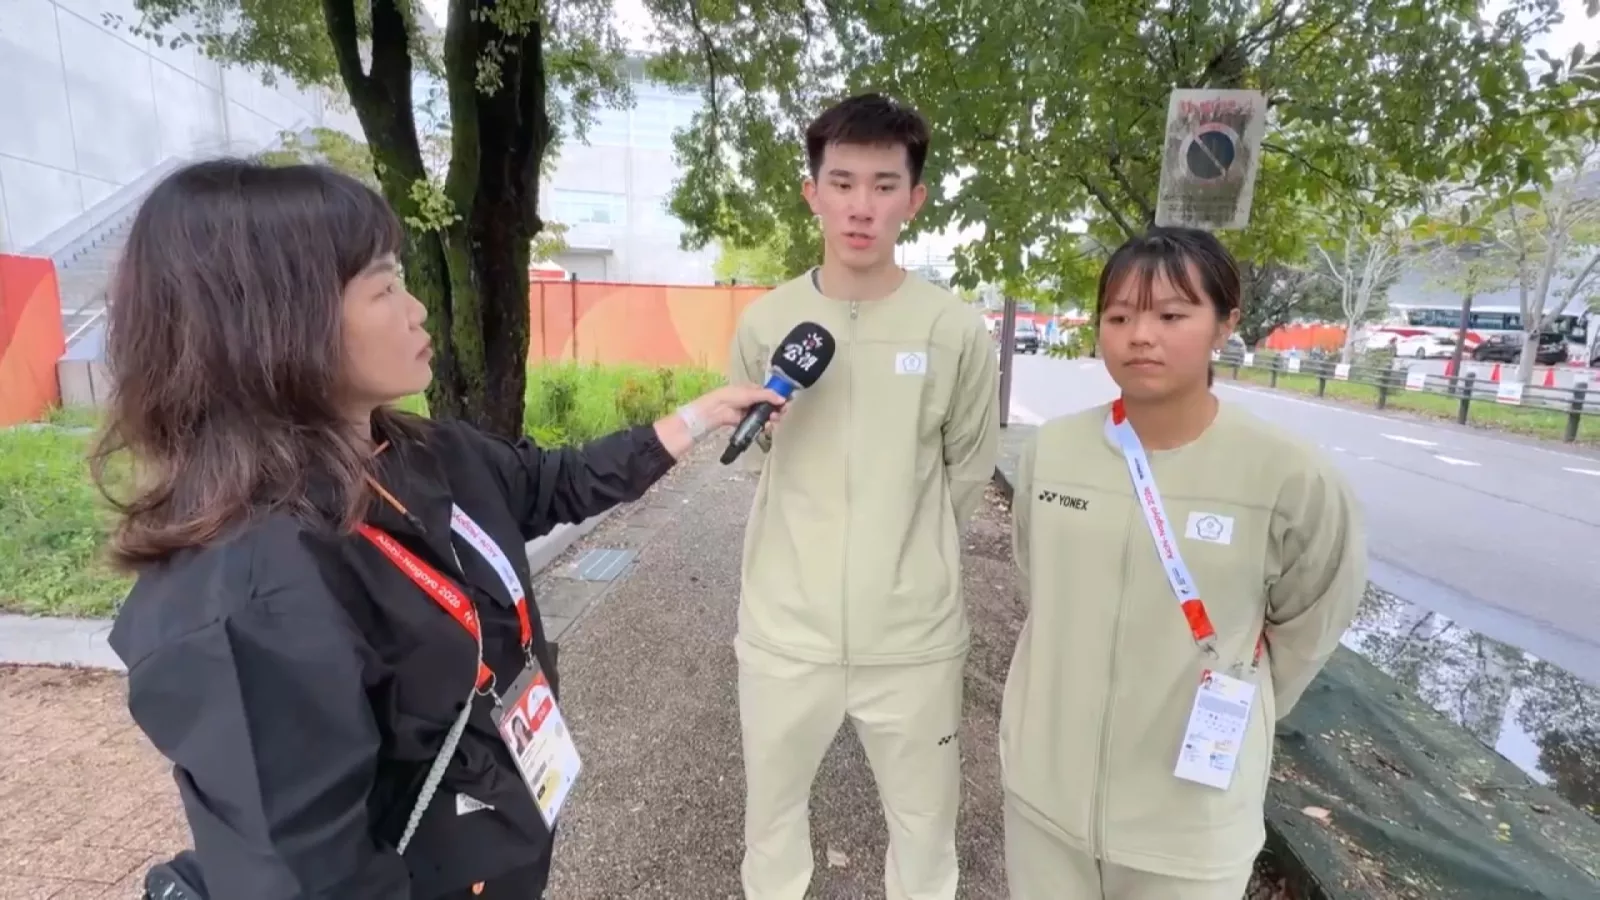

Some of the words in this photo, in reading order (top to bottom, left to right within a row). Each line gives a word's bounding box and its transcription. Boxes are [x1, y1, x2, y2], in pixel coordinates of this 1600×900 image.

[1059, 494, 1089, 511] YONEX
[1152, 507, 1173, 559] Aichi-Nagoya
[377, 536, 437, 589] Aichi-Nagoya
[439, 587, 461, 608] 2026
